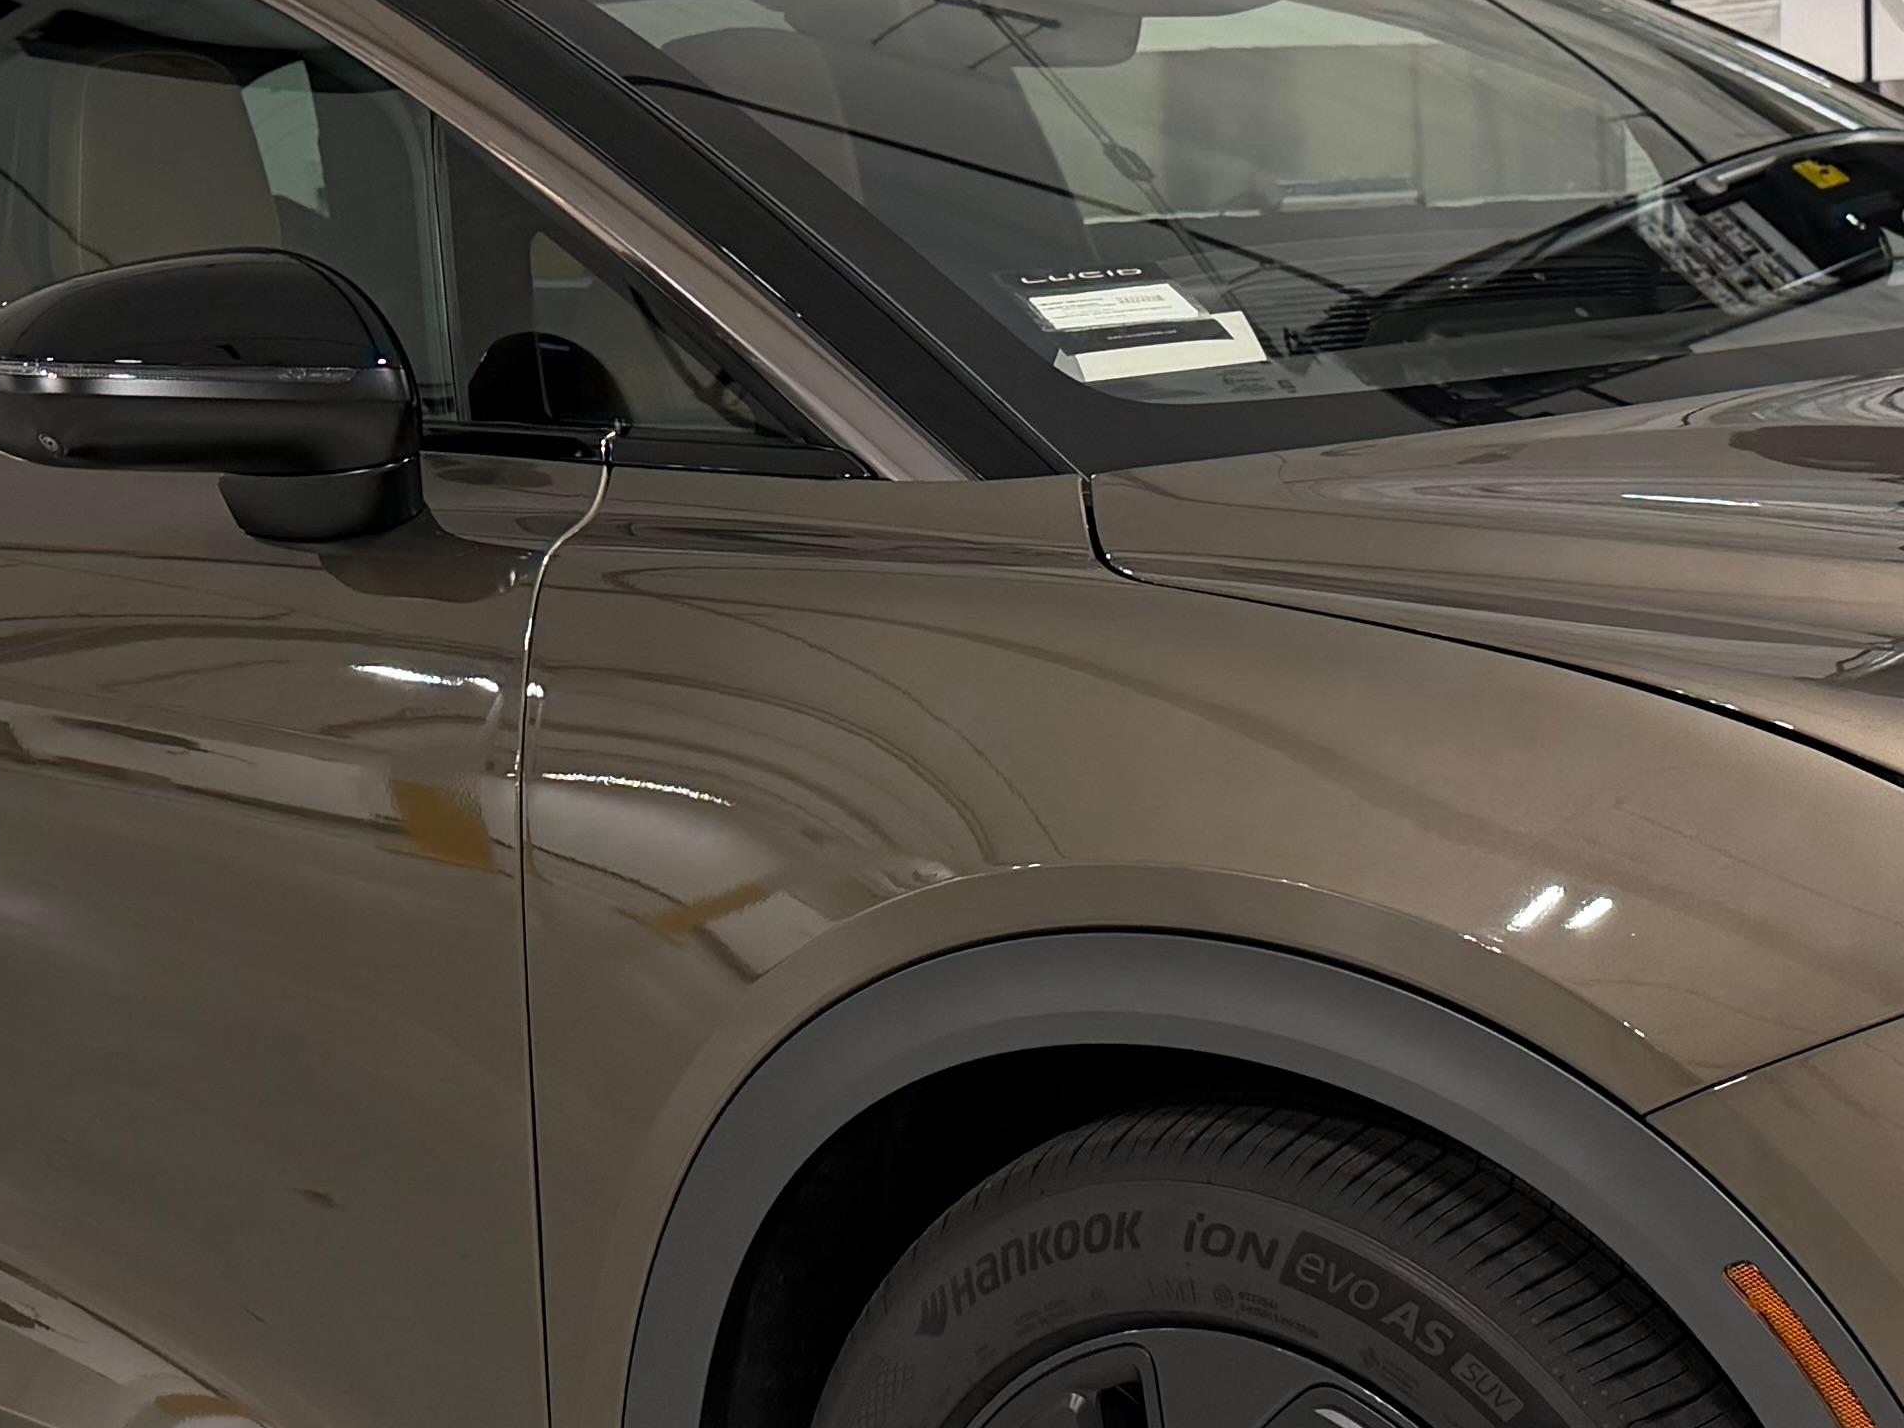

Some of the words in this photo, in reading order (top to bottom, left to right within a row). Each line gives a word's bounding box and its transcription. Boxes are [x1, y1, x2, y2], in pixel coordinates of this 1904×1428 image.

[1020, 268, 1142, 284] LUCID
[1295, 1252, 1380, 1311] evo
[1382, 1299, 1455, 1358] AS
[1457, 1360, 1515, 1409] SUV
